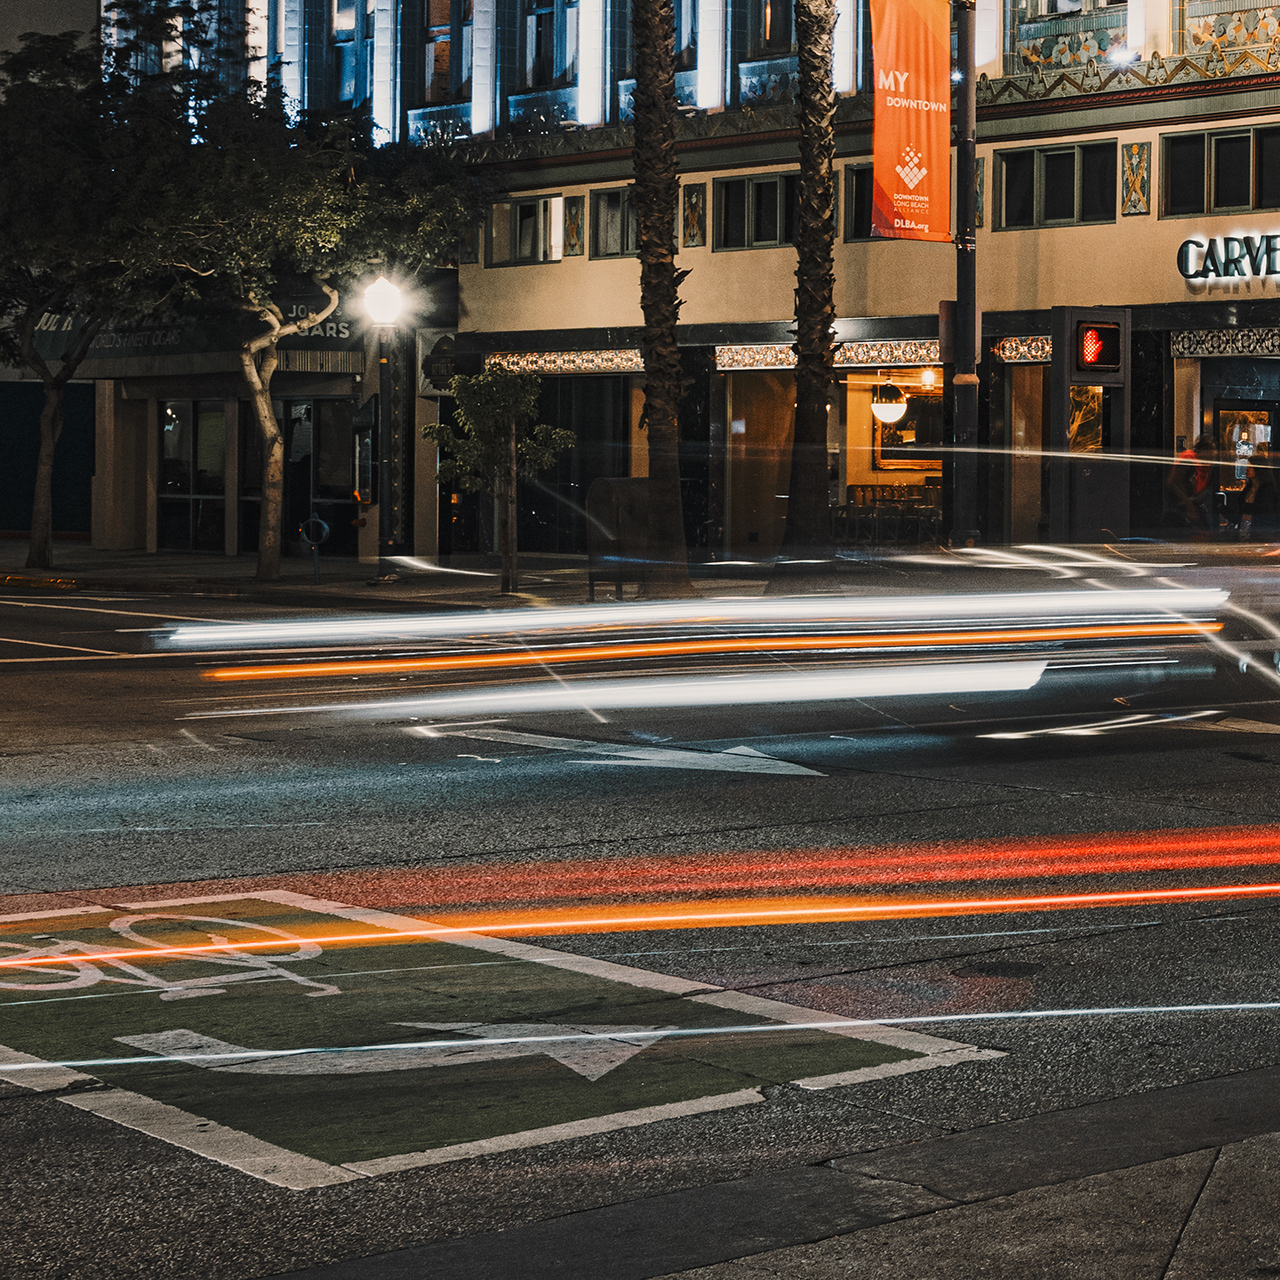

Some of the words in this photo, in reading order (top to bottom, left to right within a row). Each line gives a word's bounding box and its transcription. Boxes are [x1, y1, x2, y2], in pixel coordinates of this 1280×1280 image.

[878, 68, 909, 93] MY
[886, 96, 947, 112] DOWNTOWN
[894, 193, 929, 202] DOWNTOWN
[894, 207, 930, 215] ALLIANCE
[911, 201, 929, 209] BEACH
[894, 218, 930, 233] DLBA.org
